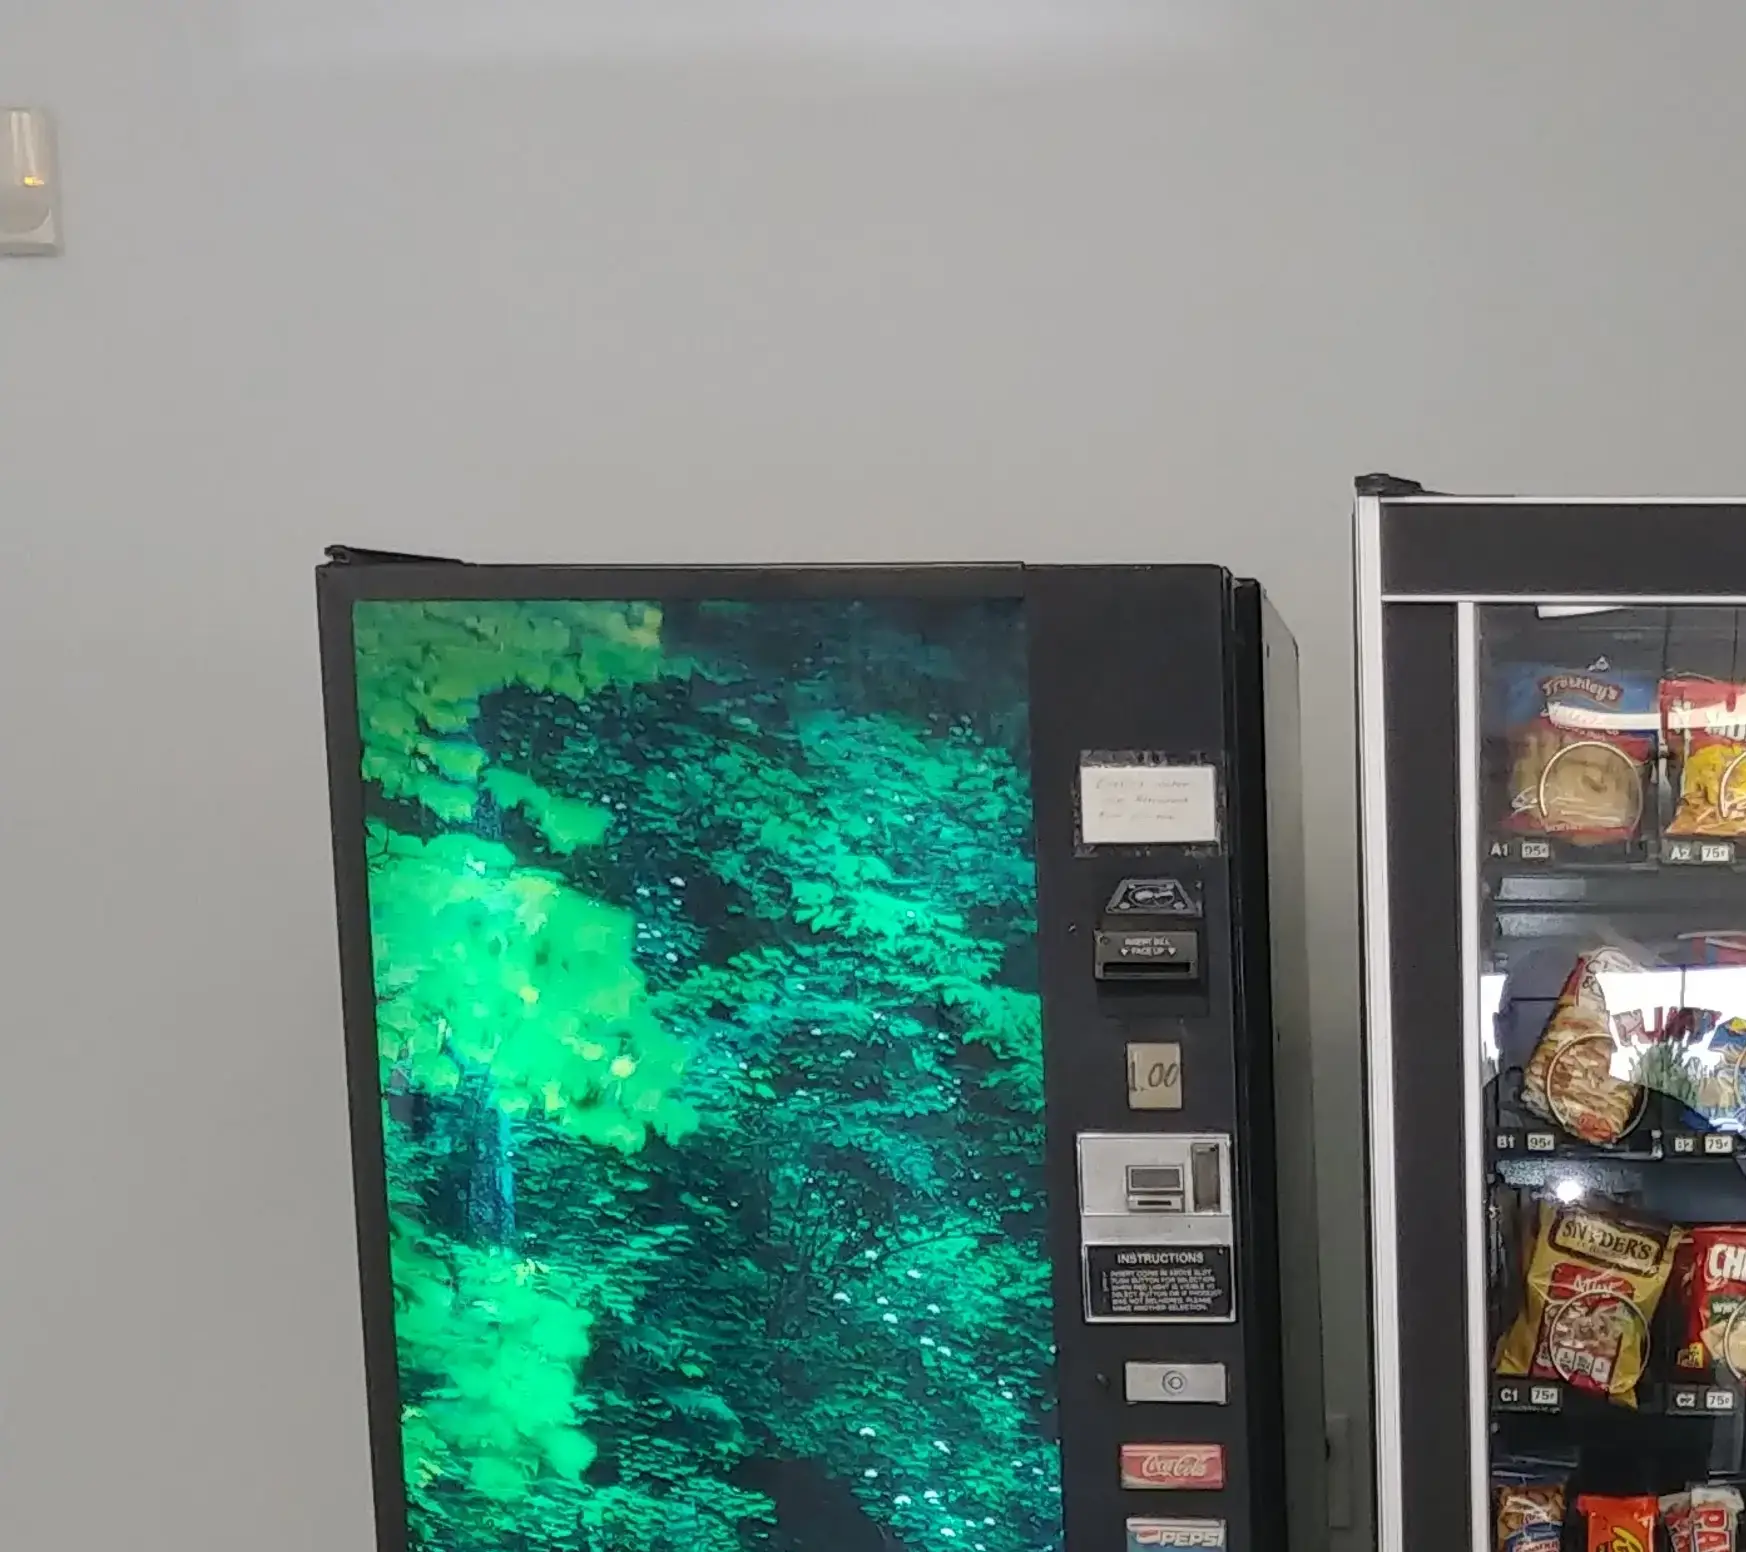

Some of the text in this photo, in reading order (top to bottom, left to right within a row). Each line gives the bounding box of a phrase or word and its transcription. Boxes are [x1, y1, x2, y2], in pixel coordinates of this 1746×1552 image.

[1129, 1060, 1179, 1093] 1.00
[1562, 1219, 1652, 1261] SNYDER'S
[1117, 1251, 1204, 1264] INSTRUCTIONS
[1160, 1530, 1224, 1547] PEPSI
